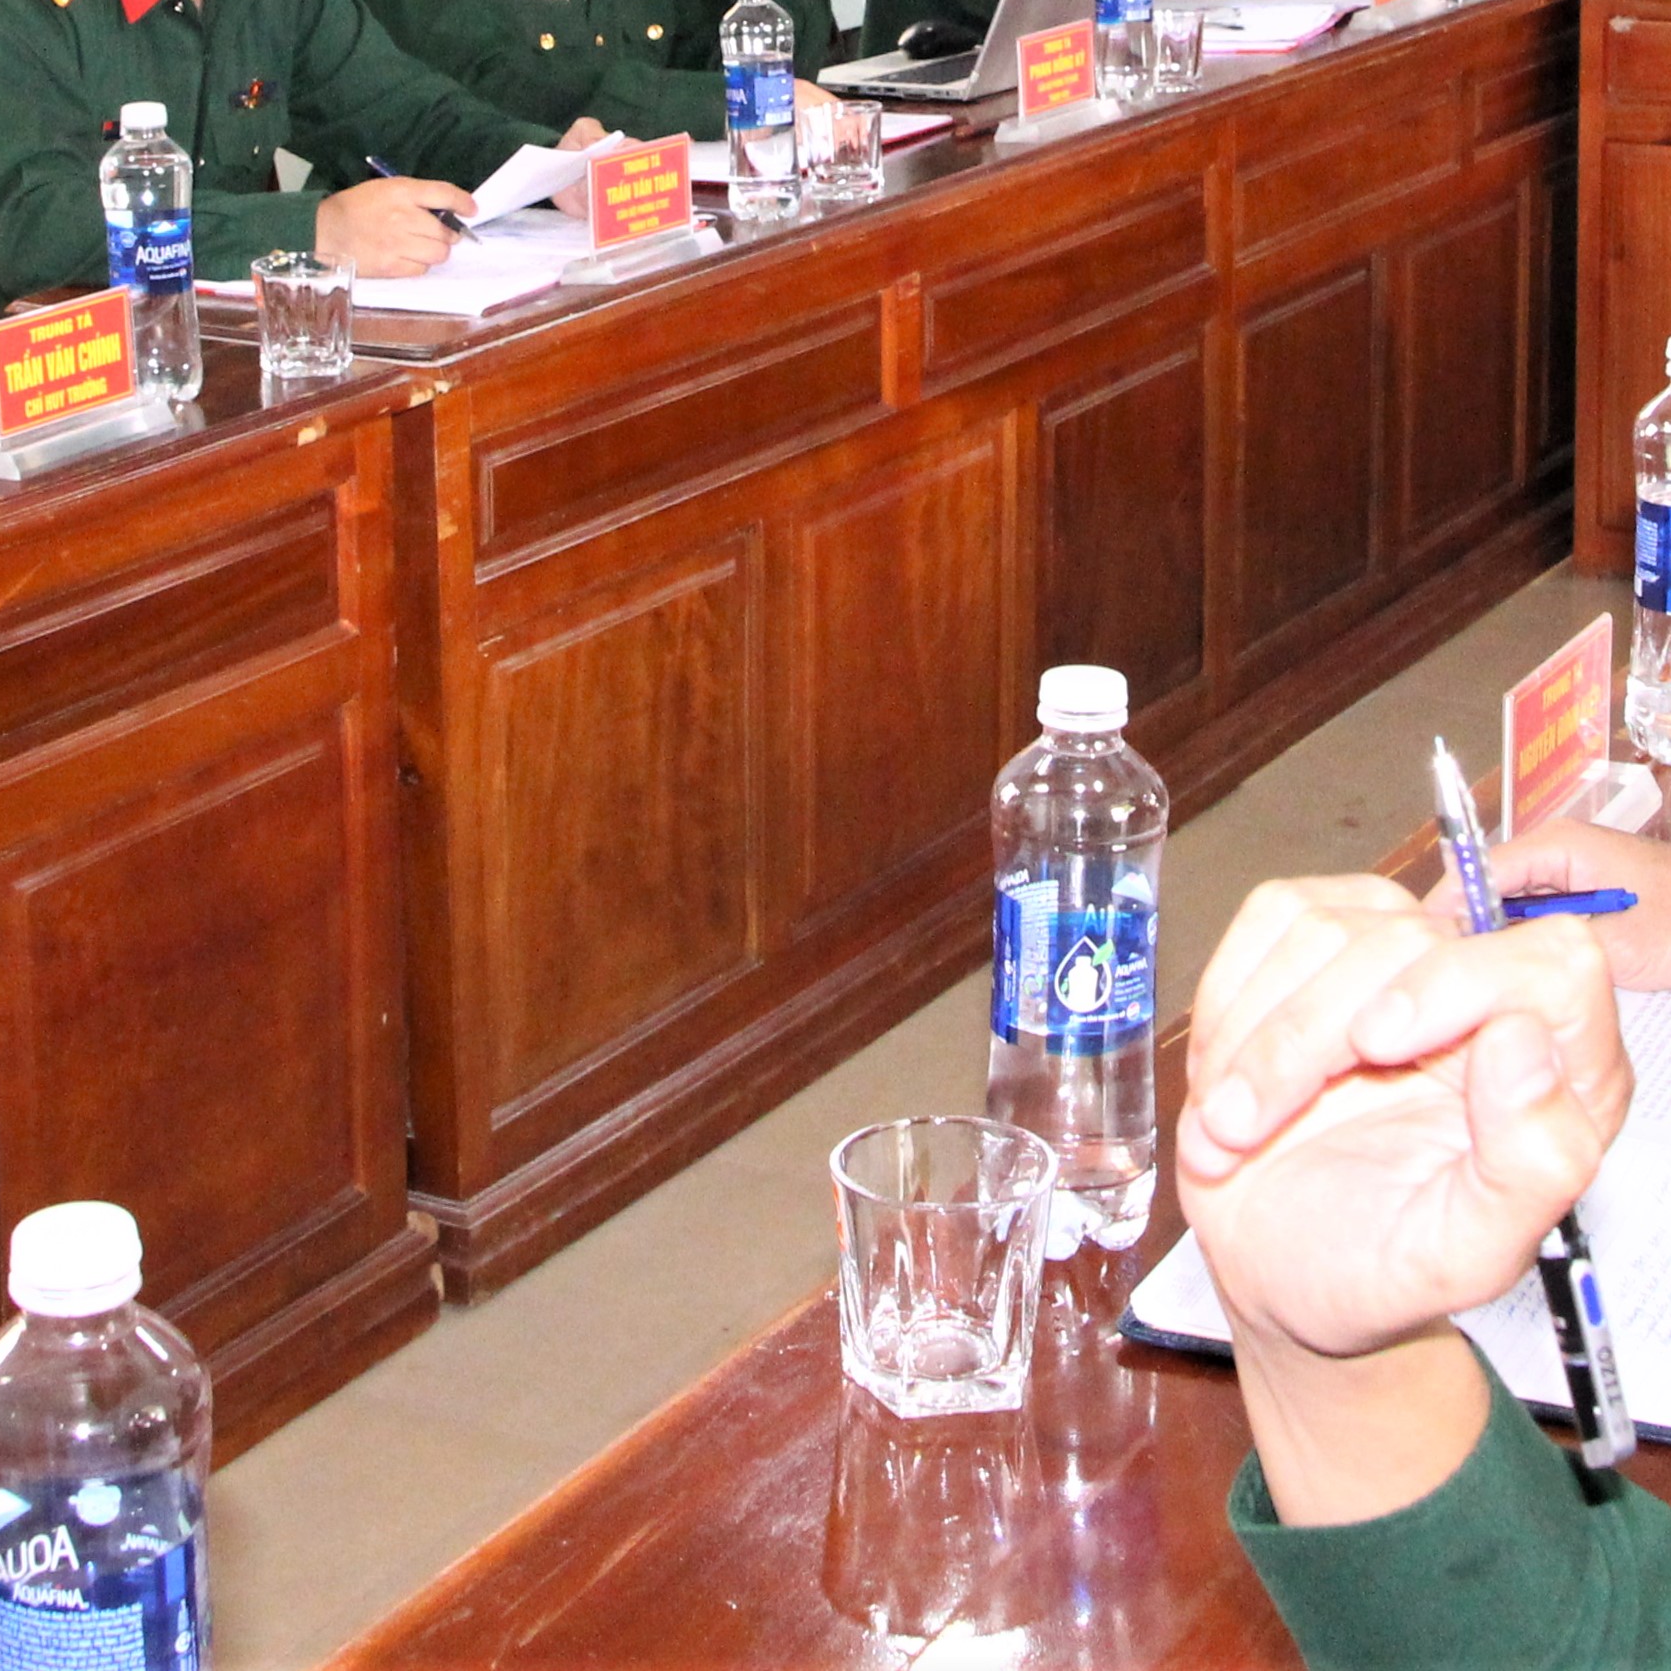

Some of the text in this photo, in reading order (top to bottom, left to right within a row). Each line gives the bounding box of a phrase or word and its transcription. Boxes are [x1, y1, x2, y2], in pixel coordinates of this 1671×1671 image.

[29, 309, 93, 345] TRUNG TÁ
[45, 344, 76, 382] VĂN
[77, 330, 122, 372] CHÍNH
[11, 1580, 84, 1610] AQUAFINA
